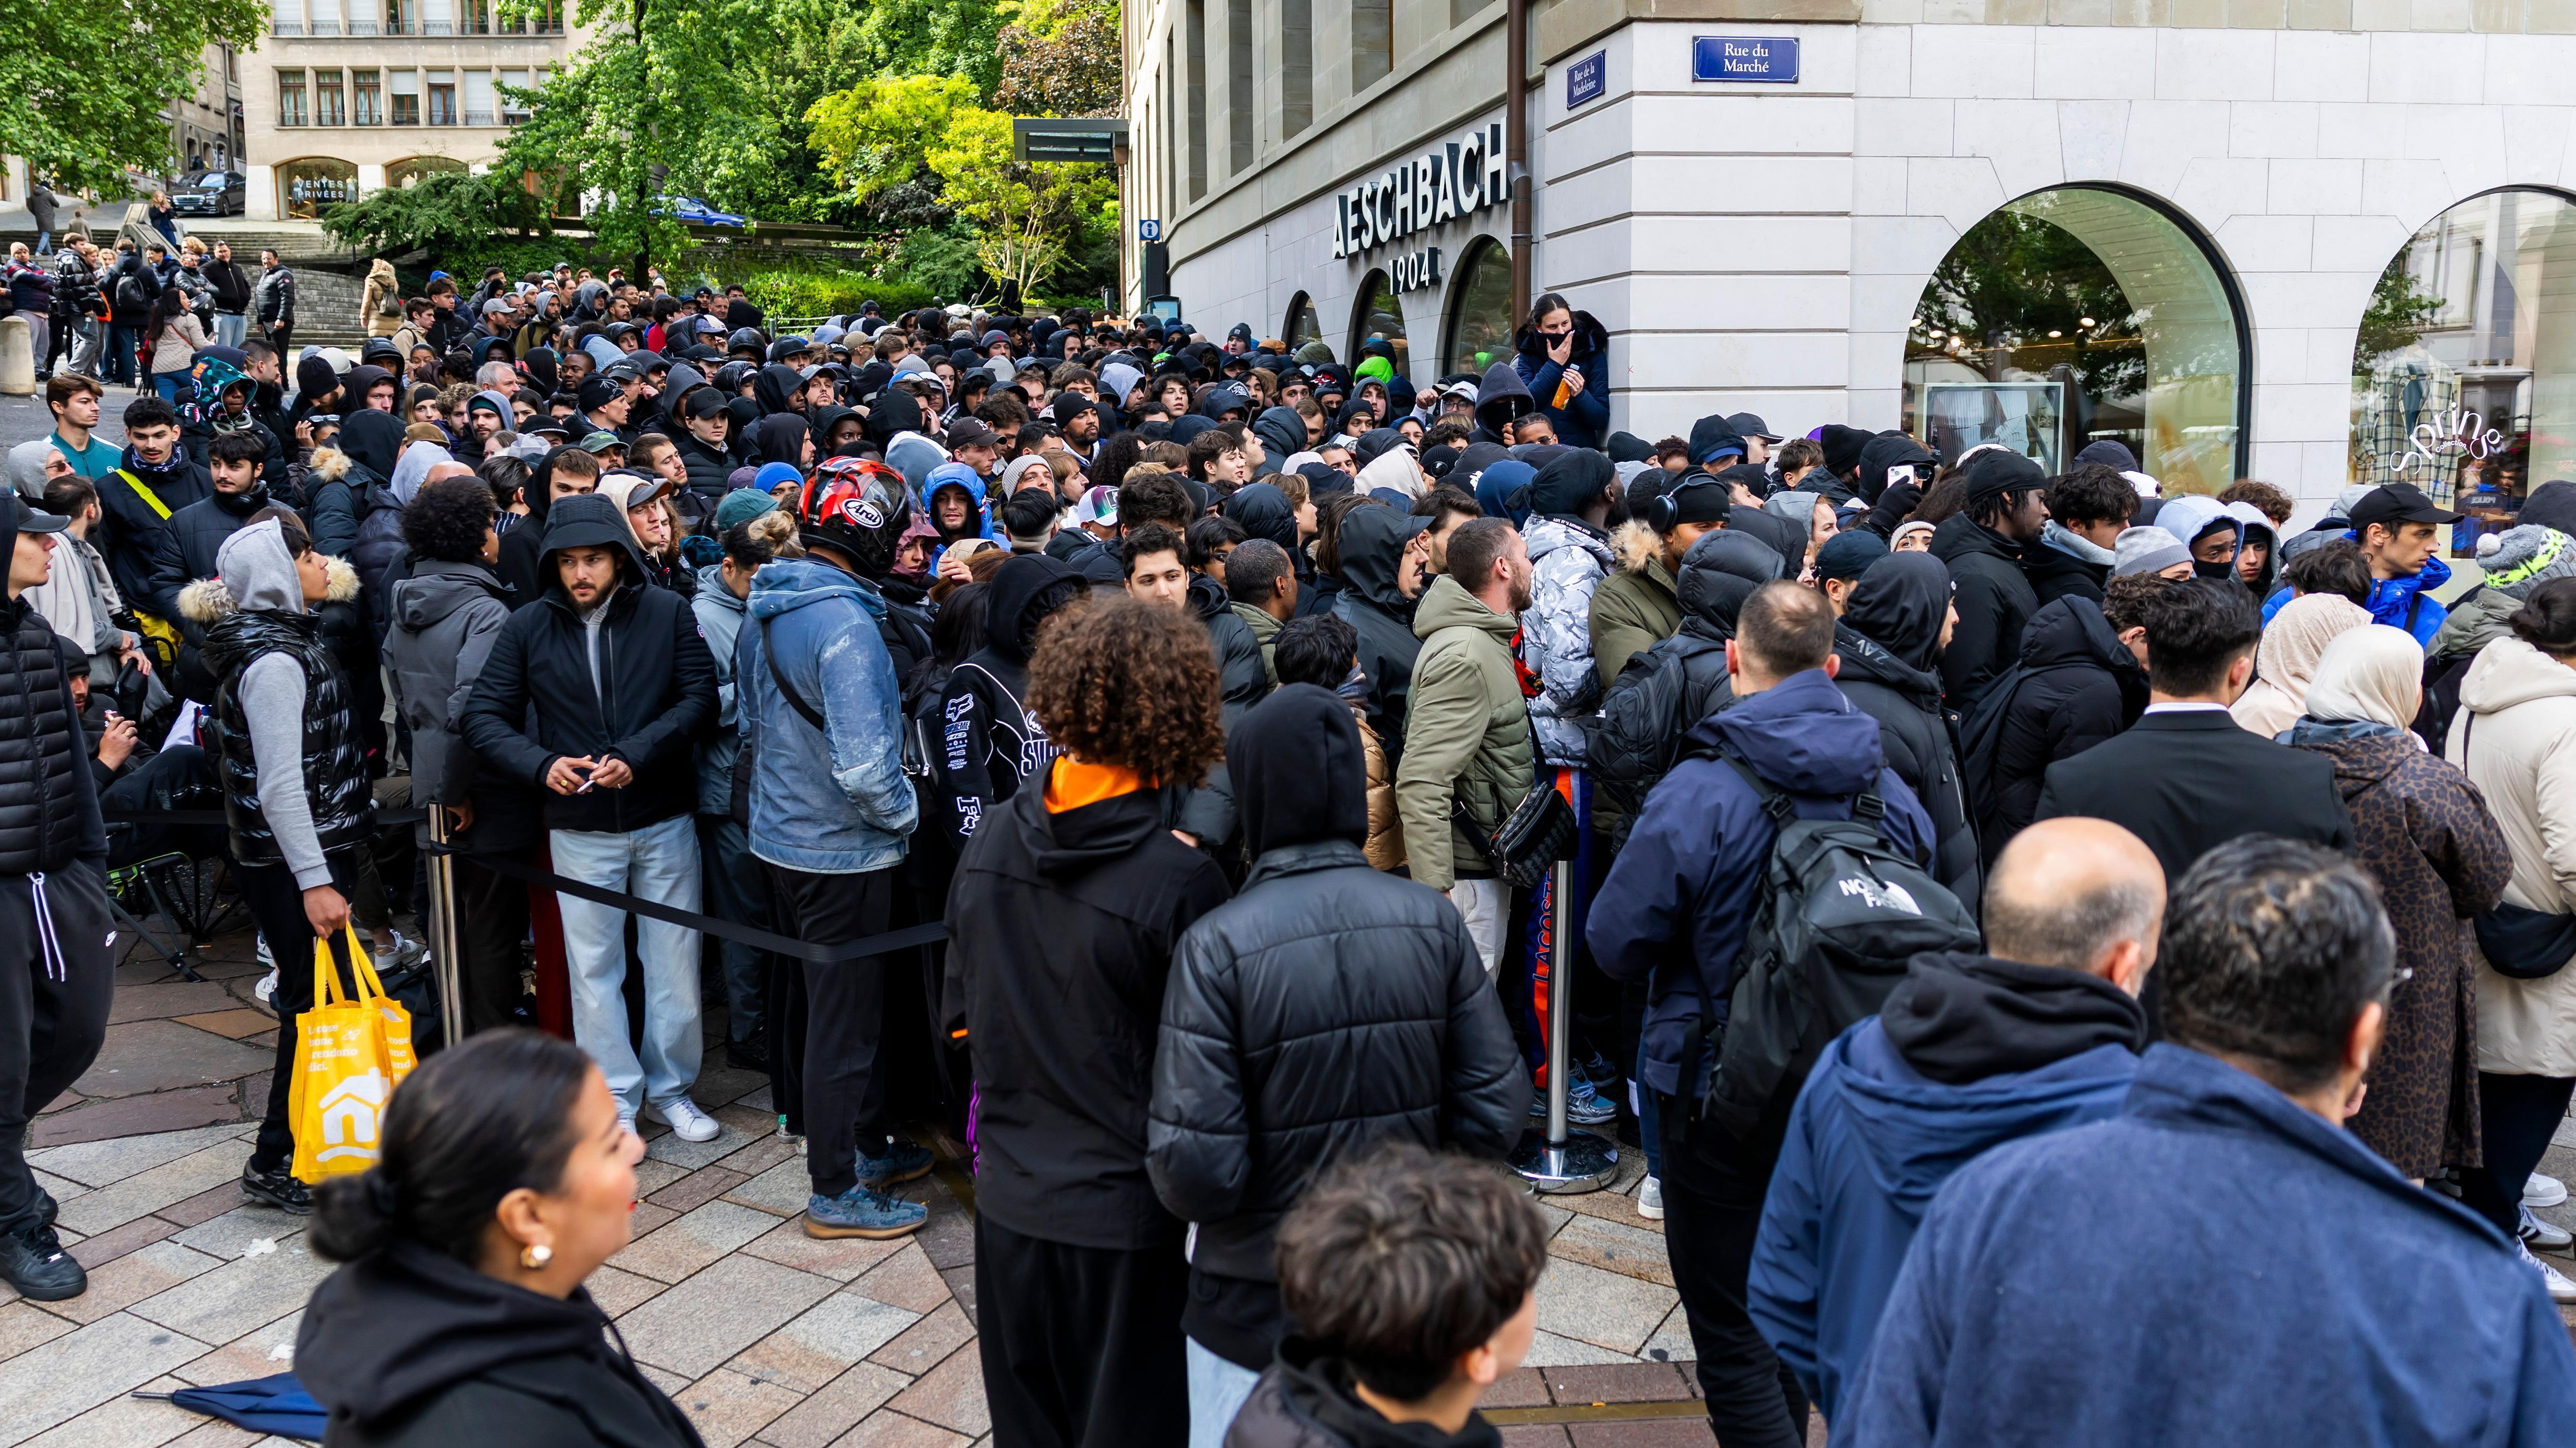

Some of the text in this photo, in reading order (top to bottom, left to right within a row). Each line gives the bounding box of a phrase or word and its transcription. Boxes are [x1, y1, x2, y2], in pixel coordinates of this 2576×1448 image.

[1725, 43, 1769, 57] Rue du
[1574, 62, 1595, 82] Rue de la
[1724, 59, 1769, 73] Marché
[1573, 78, 1596, 98] Madeleine
[297, 180, 344, 189] VENTES
[1332, 116, 1508, 260] AESCHBACH
[298, 189, 344, 198] PRIVÉES
[1388, 247, 1430, 295] 1904
[2389, 402, 2503, 475] Spring
[2436, 439, 2467, 453] Collection
[847, 501, 879, 523] Arai
[944, 720, 971, 735] SUPREME
[1533, 867, 1552, 982] LACOST
[311, 1048, 358, 1058] rendono
